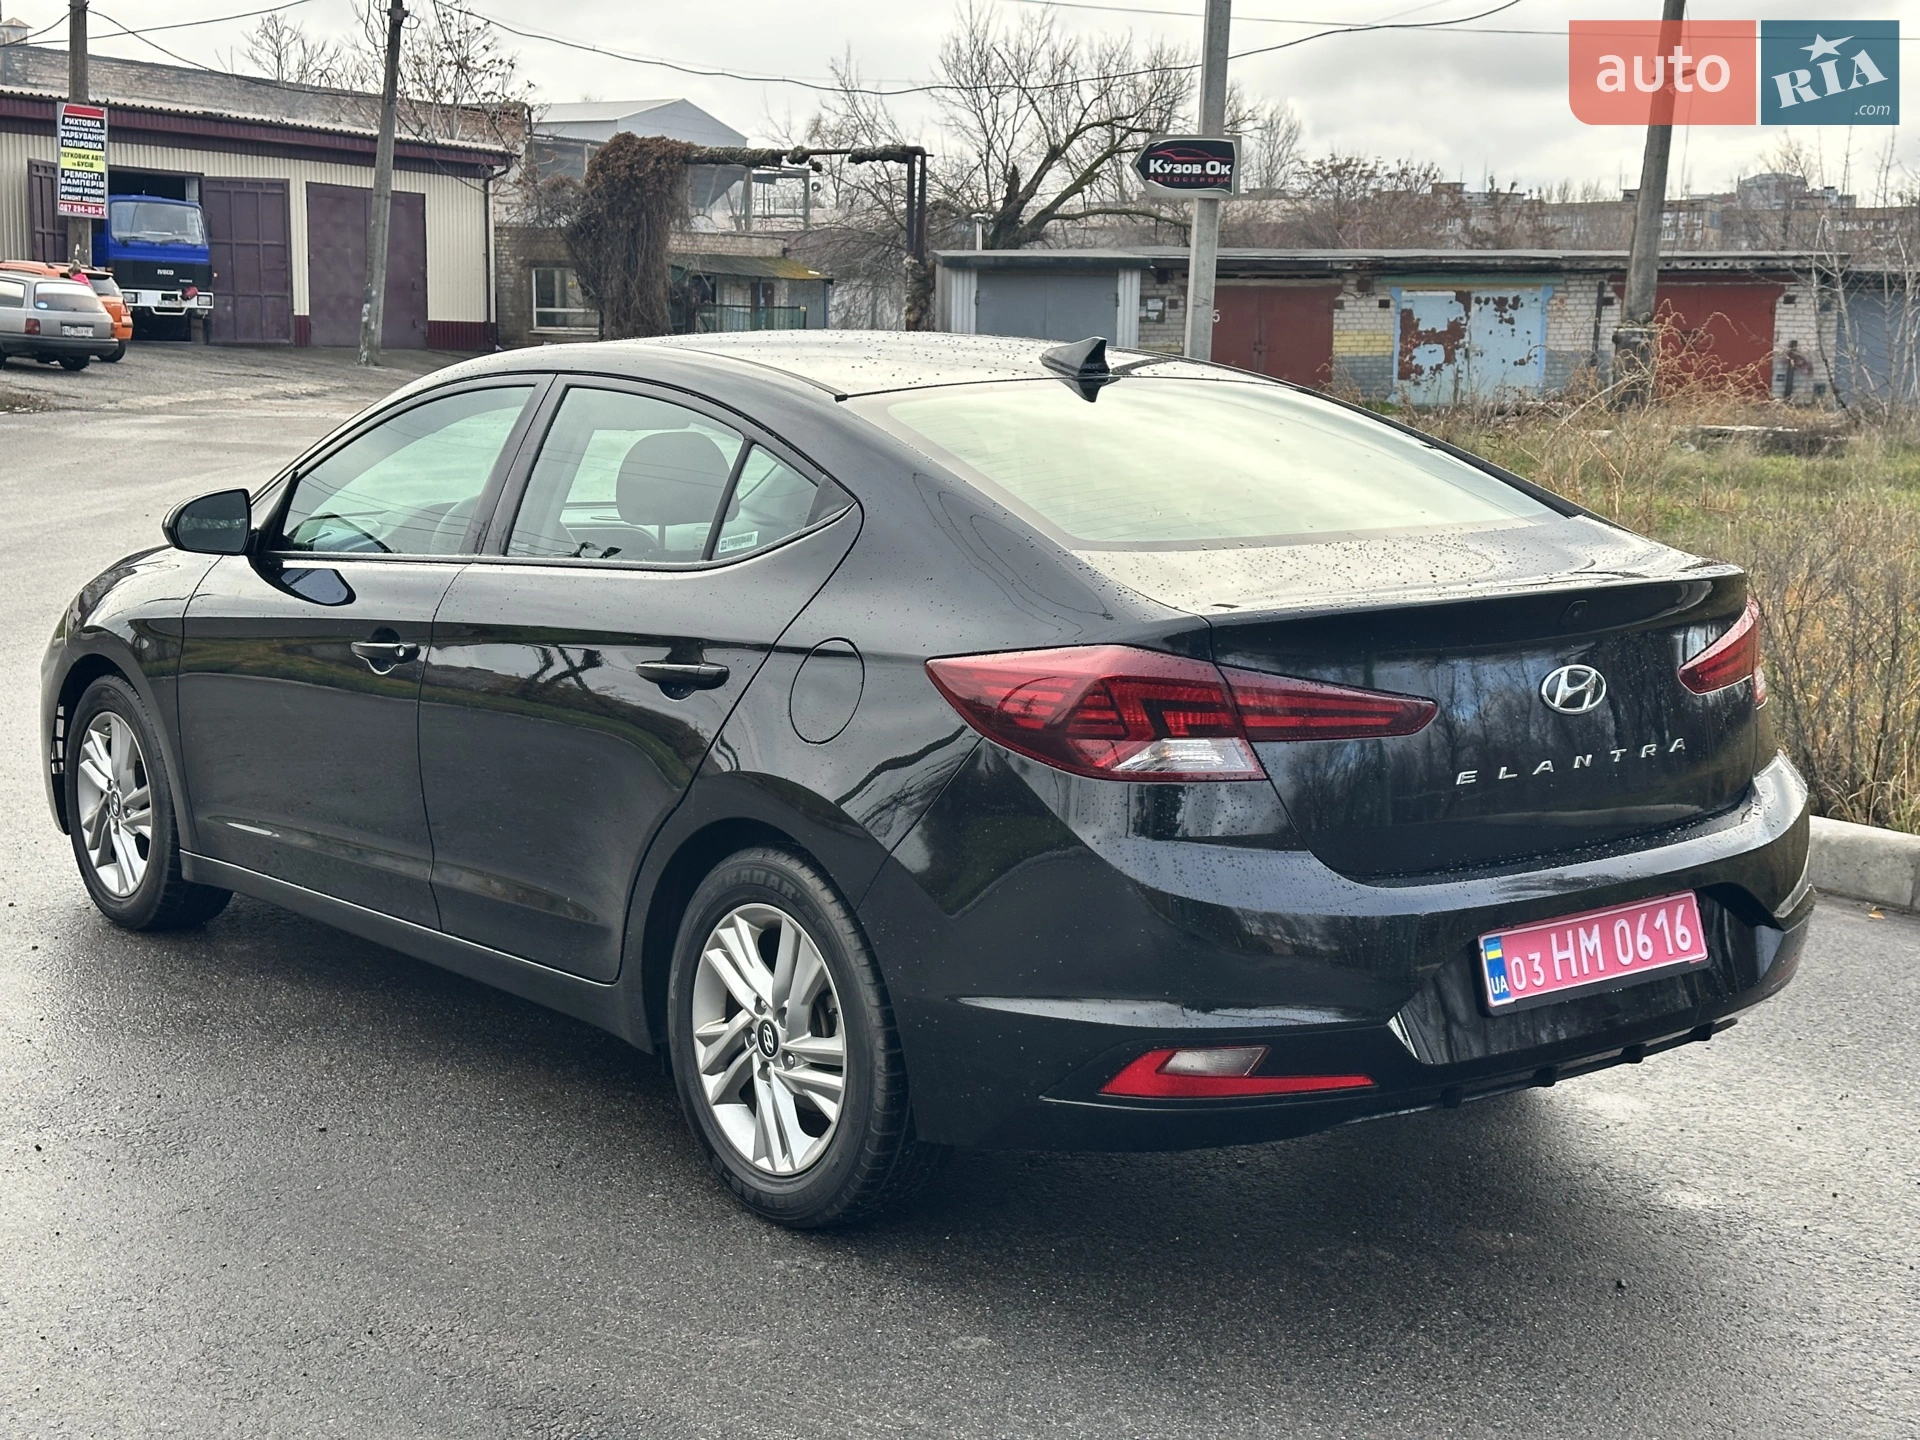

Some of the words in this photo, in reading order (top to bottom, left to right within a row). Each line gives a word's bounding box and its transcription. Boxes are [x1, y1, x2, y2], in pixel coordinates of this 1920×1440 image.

[64, 117, 101, 128] РИХТОВКА
[63, 138, 103, 150] ПОЛІРОВКА
[61, 177, 104, 188] БАМПЕРІВ
[1456, 738, 1686, 785] ELANTRA
[1511, 951, 1545, 992] 03
[1550, 923, 1605, 981] HM
[1614, 904, 1693, 967] 0616
[1491, 976, 1509, 995] UA
